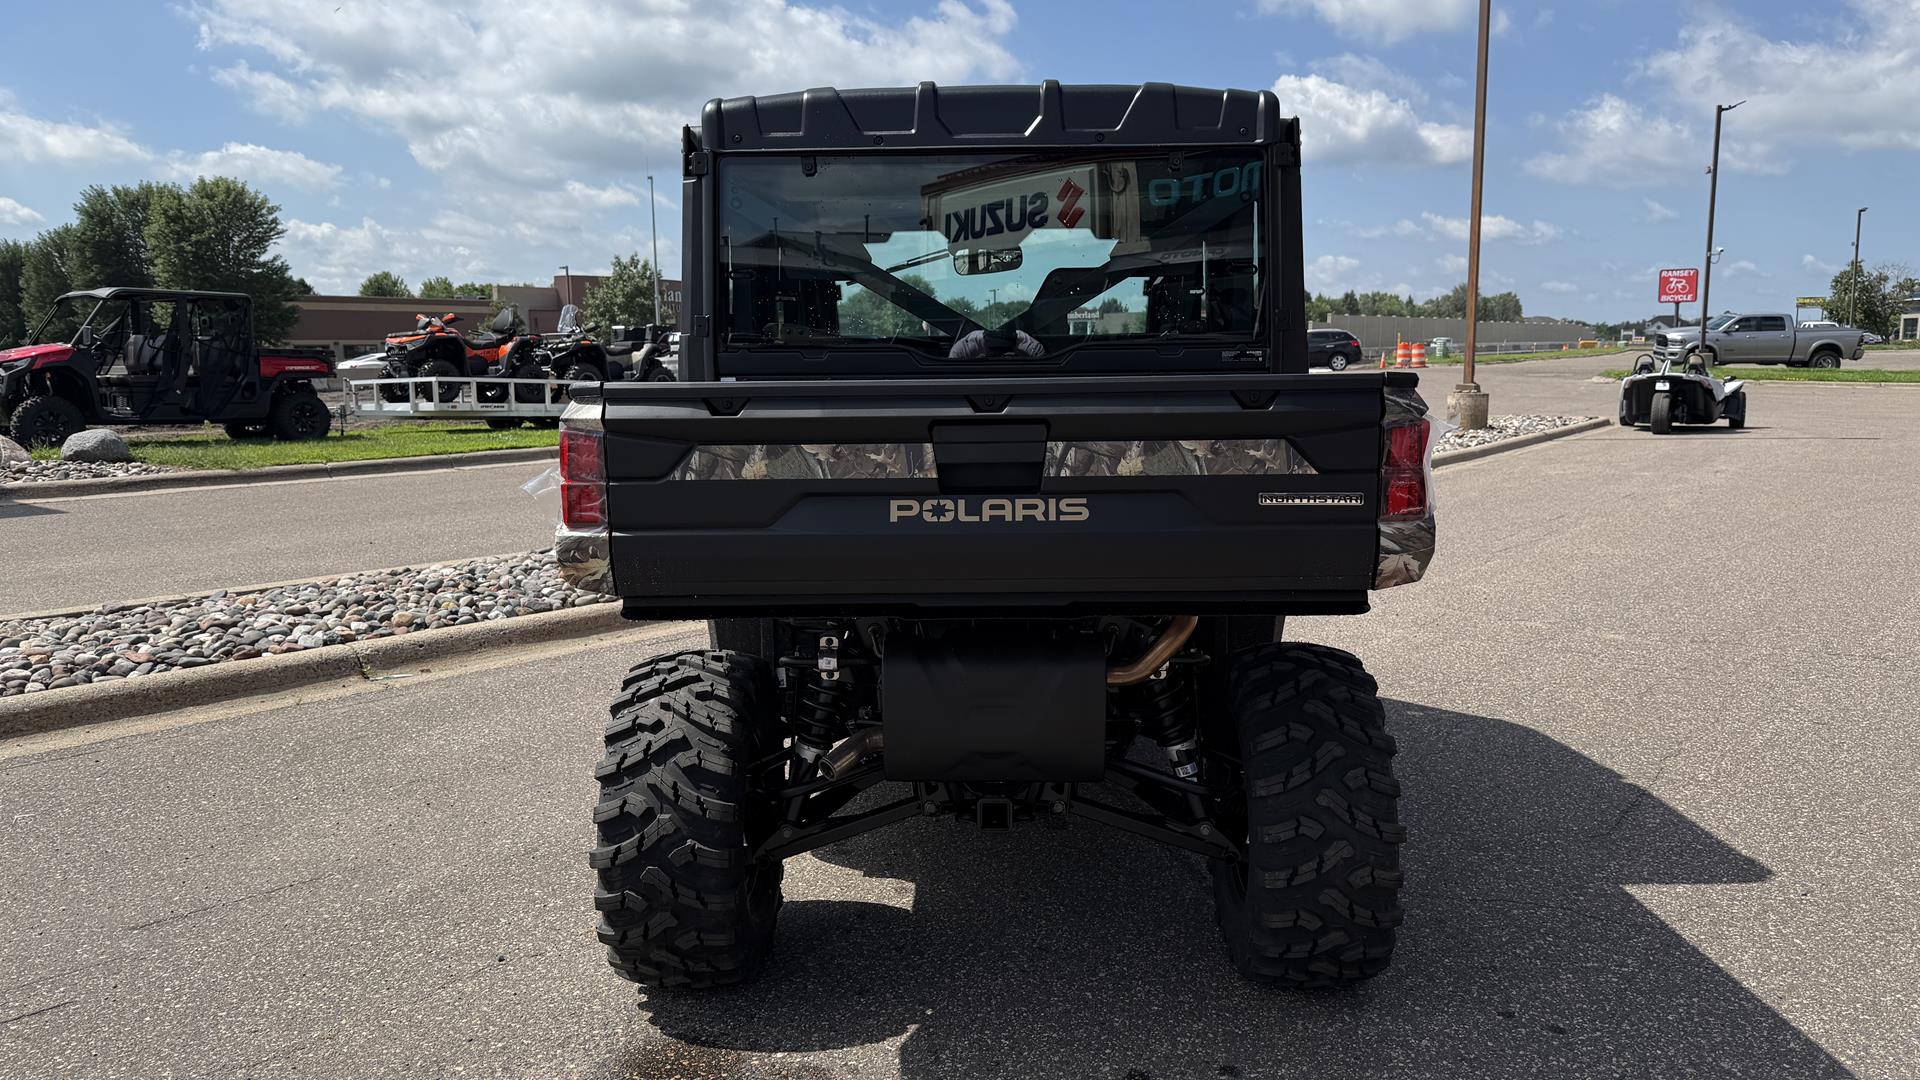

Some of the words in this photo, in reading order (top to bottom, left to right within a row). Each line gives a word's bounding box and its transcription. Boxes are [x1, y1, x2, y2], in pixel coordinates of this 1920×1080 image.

[1661, 294, 1693, 302] BICYCLE
[1262, 495, 1361, 504] NORTHSTAR
[889, 498, 1089, 522] POLARIS
